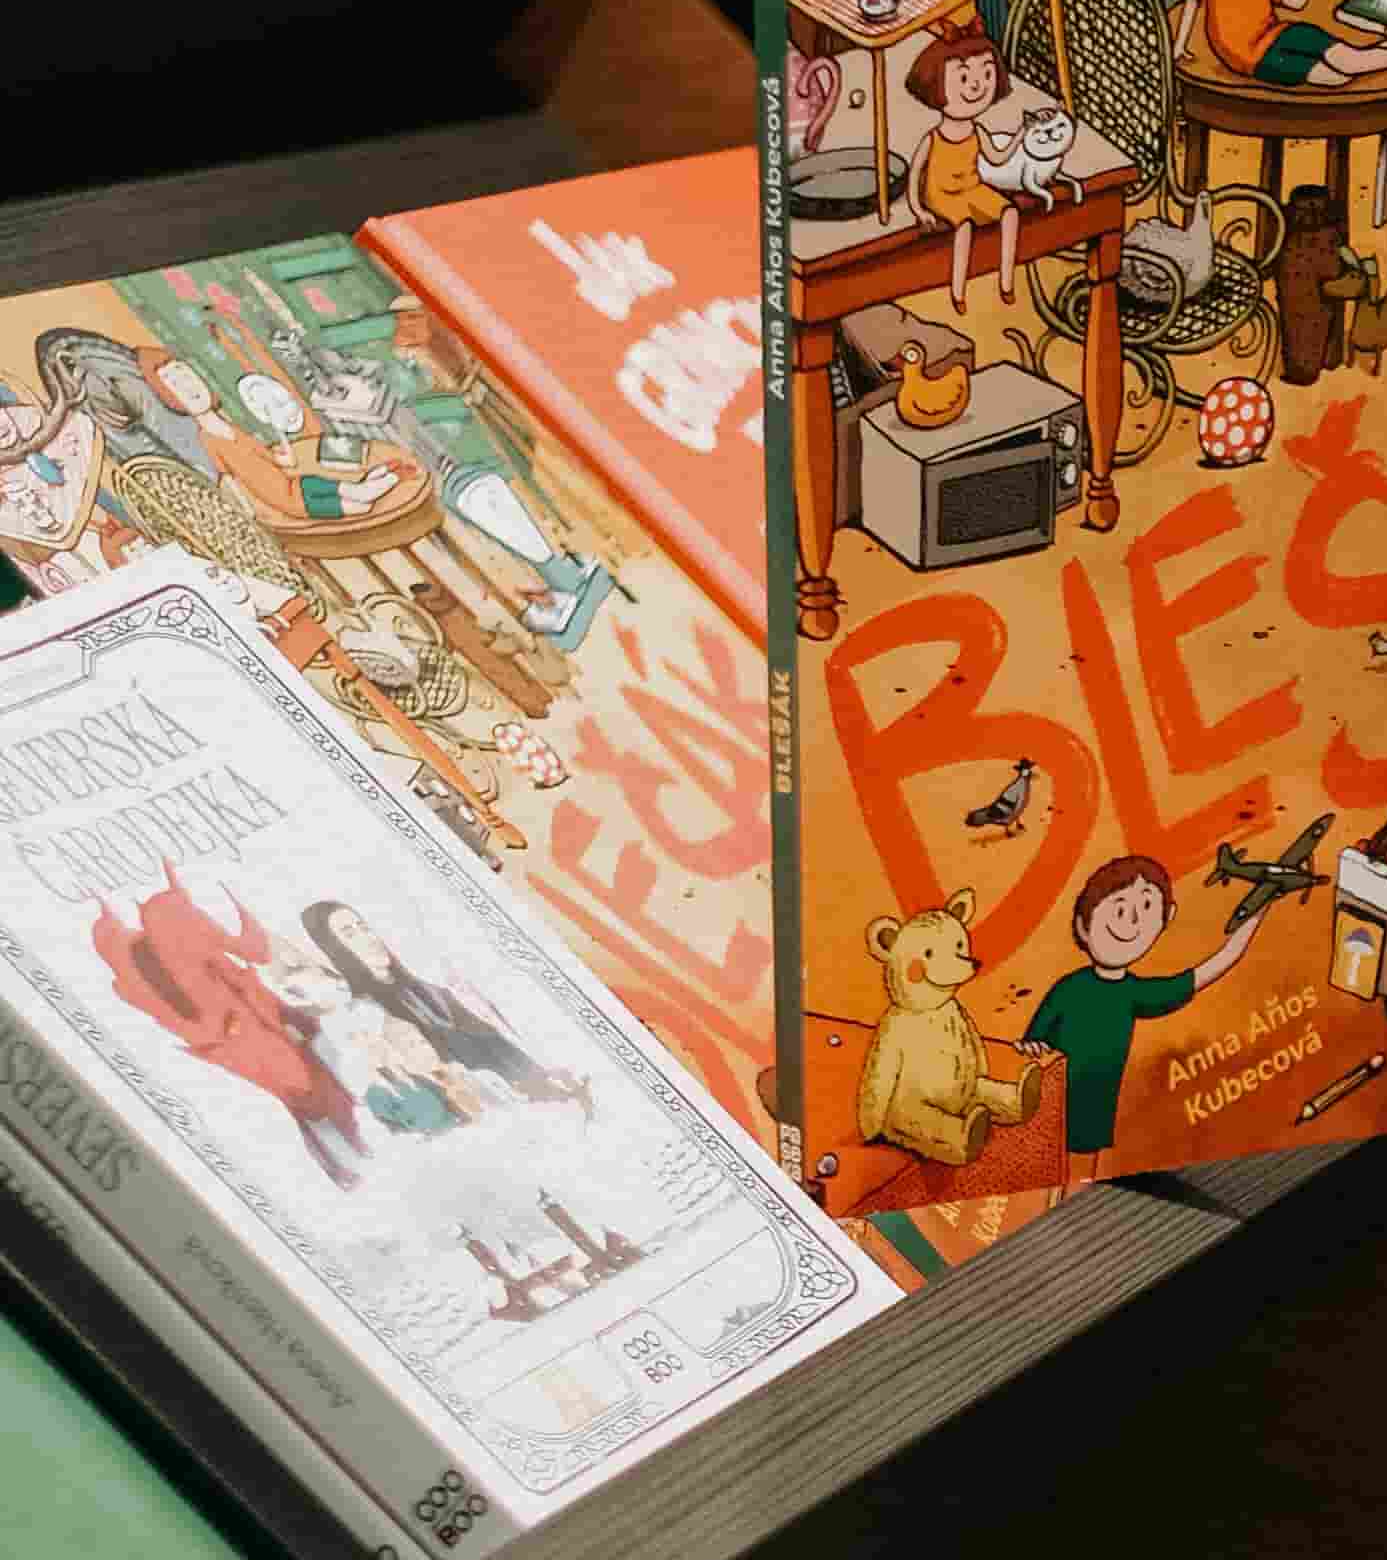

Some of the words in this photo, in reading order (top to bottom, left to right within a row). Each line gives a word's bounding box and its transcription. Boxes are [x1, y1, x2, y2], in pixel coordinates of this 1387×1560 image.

[762, 76, 784, 228] Kubecová
[767, 320, 787, 401] Anna
[772, 671, 793, 794] BLEŠÁK
[1167, 1031, 1242, 1093] Anna
[1183, 1021, 1324, 1127] Kubecová
